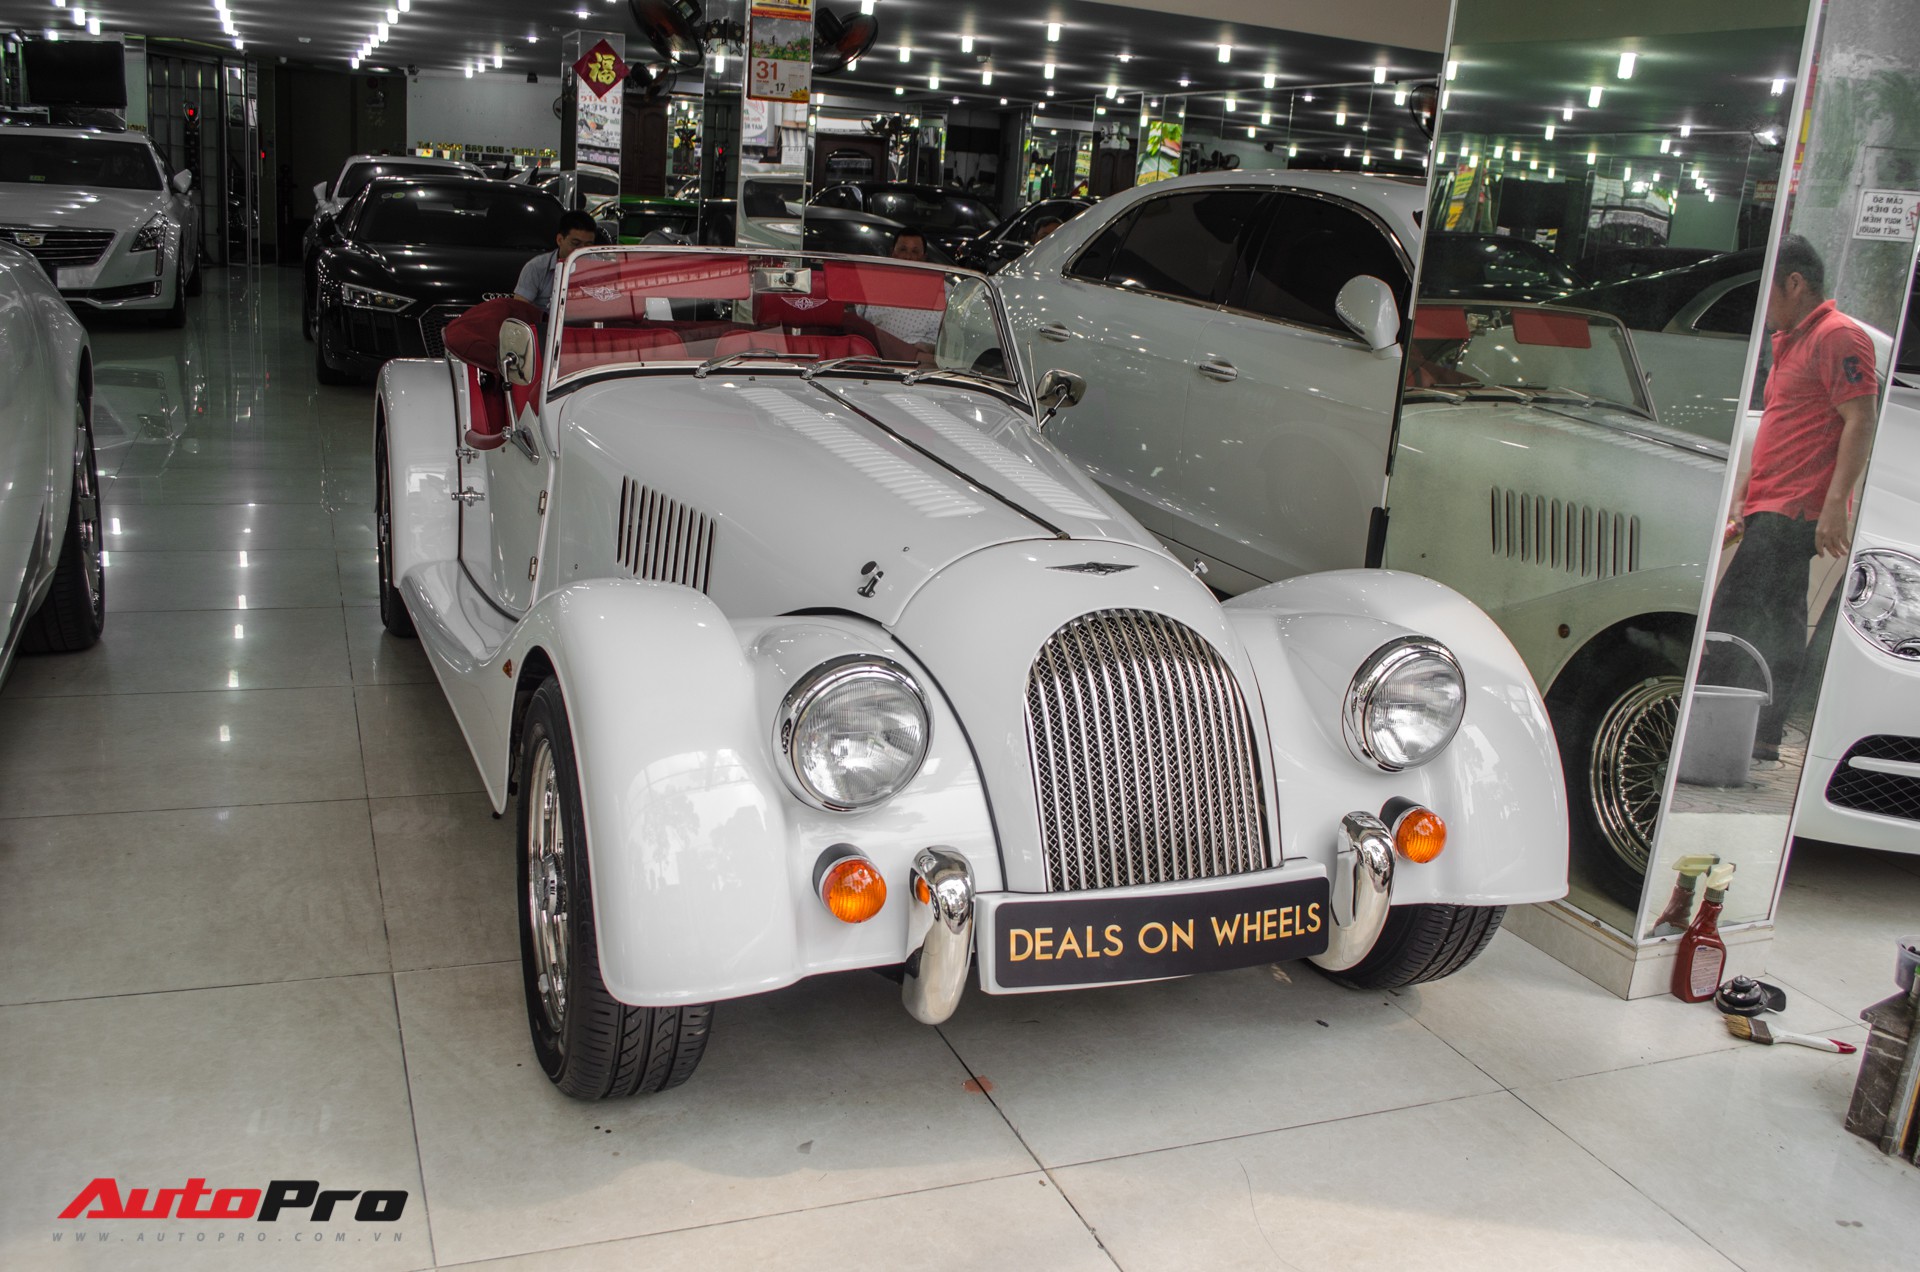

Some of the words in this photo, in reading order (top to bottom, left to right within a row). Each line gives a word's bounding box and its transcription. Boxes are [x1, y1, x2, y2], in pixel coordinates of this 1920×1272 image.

[588, 52, 616, 85] 福
[756, 60, 778, 80] 31
[775, 82, 786, 92] 17
[1009, 924, 1124, 962] DEALS
[1138, 918, 1194, 954] ON
[1211, 902, 1322, 947] WHEELS
